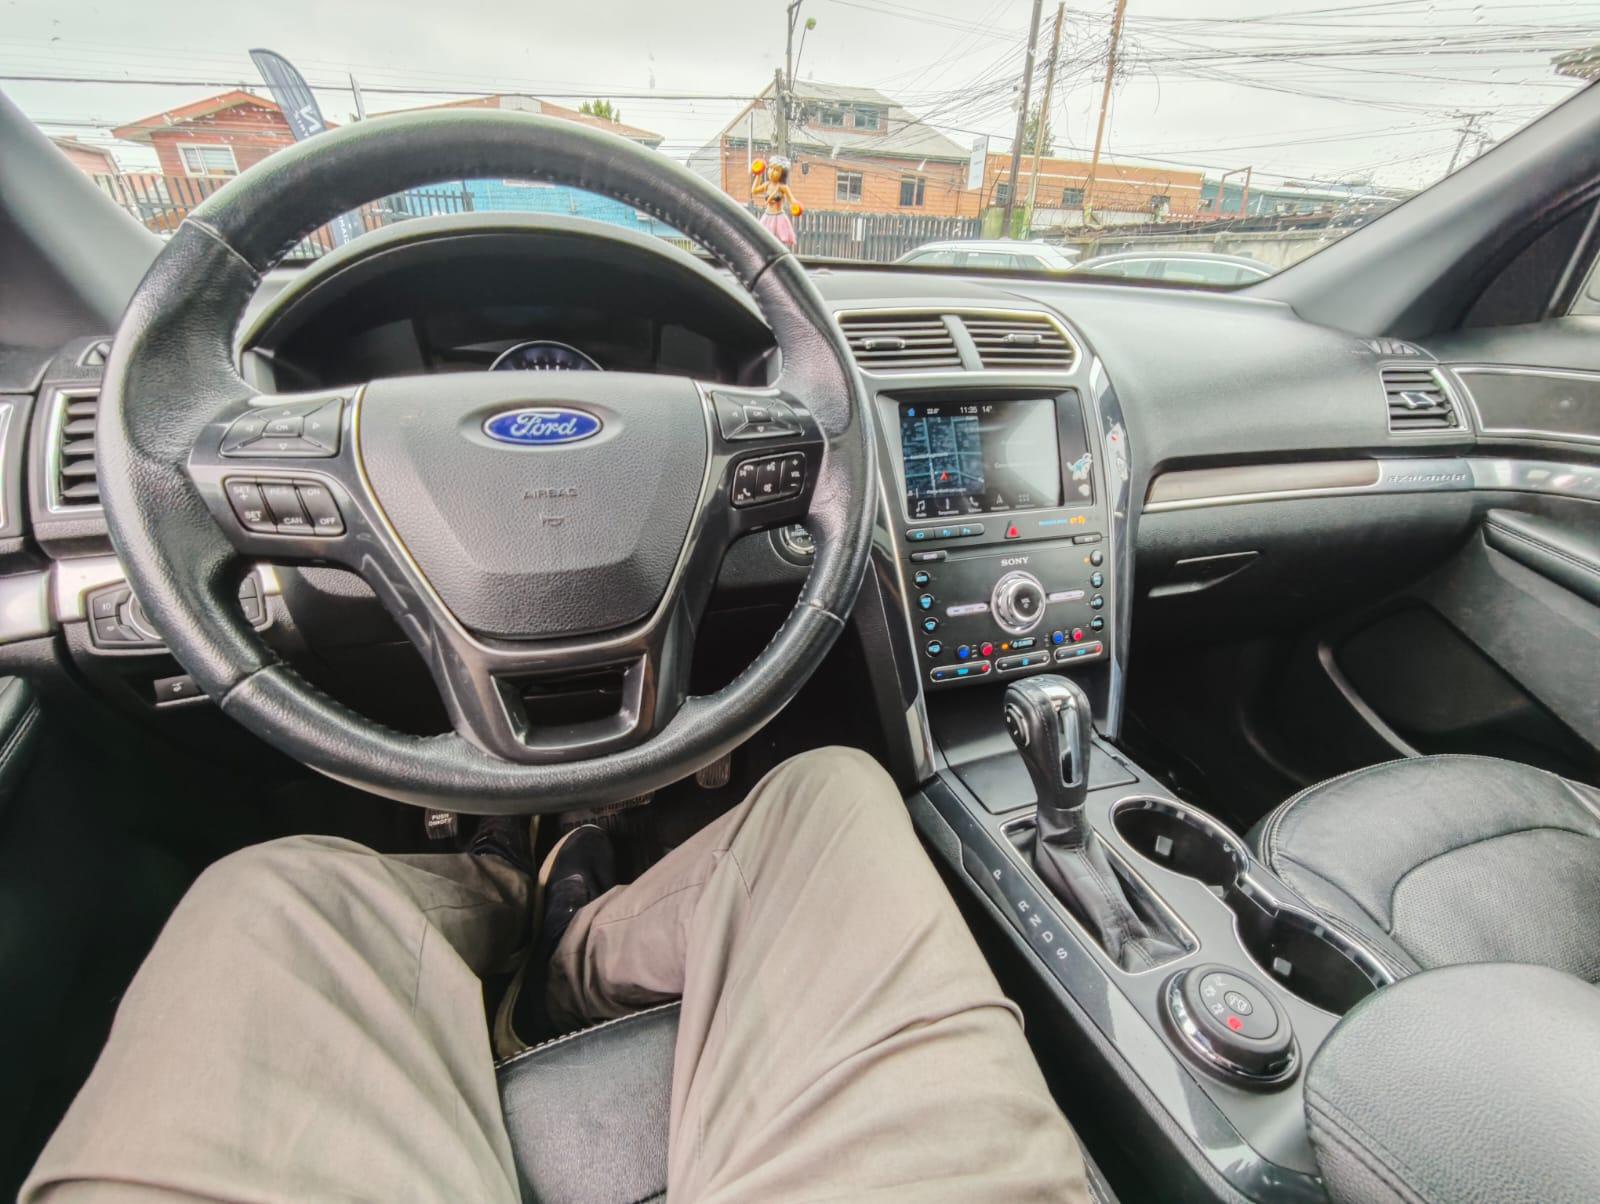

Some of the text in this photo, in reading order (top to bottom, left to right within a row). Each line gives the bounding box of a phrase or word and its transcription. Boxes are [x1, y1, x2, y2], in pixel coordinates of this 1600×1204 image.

[510, 413, 577, 436] Ford
[233, 485, 250, 494] SET
[306, 487, 321, 496] ON
[523, 488, 578, 499] AIRBAG
[244, 510, 261, 519] SET
[319, 517, 336, 525] OFF
[1001, 556, 1030, 567] SONY
[993, 869, 1068, 959] P R N D S
